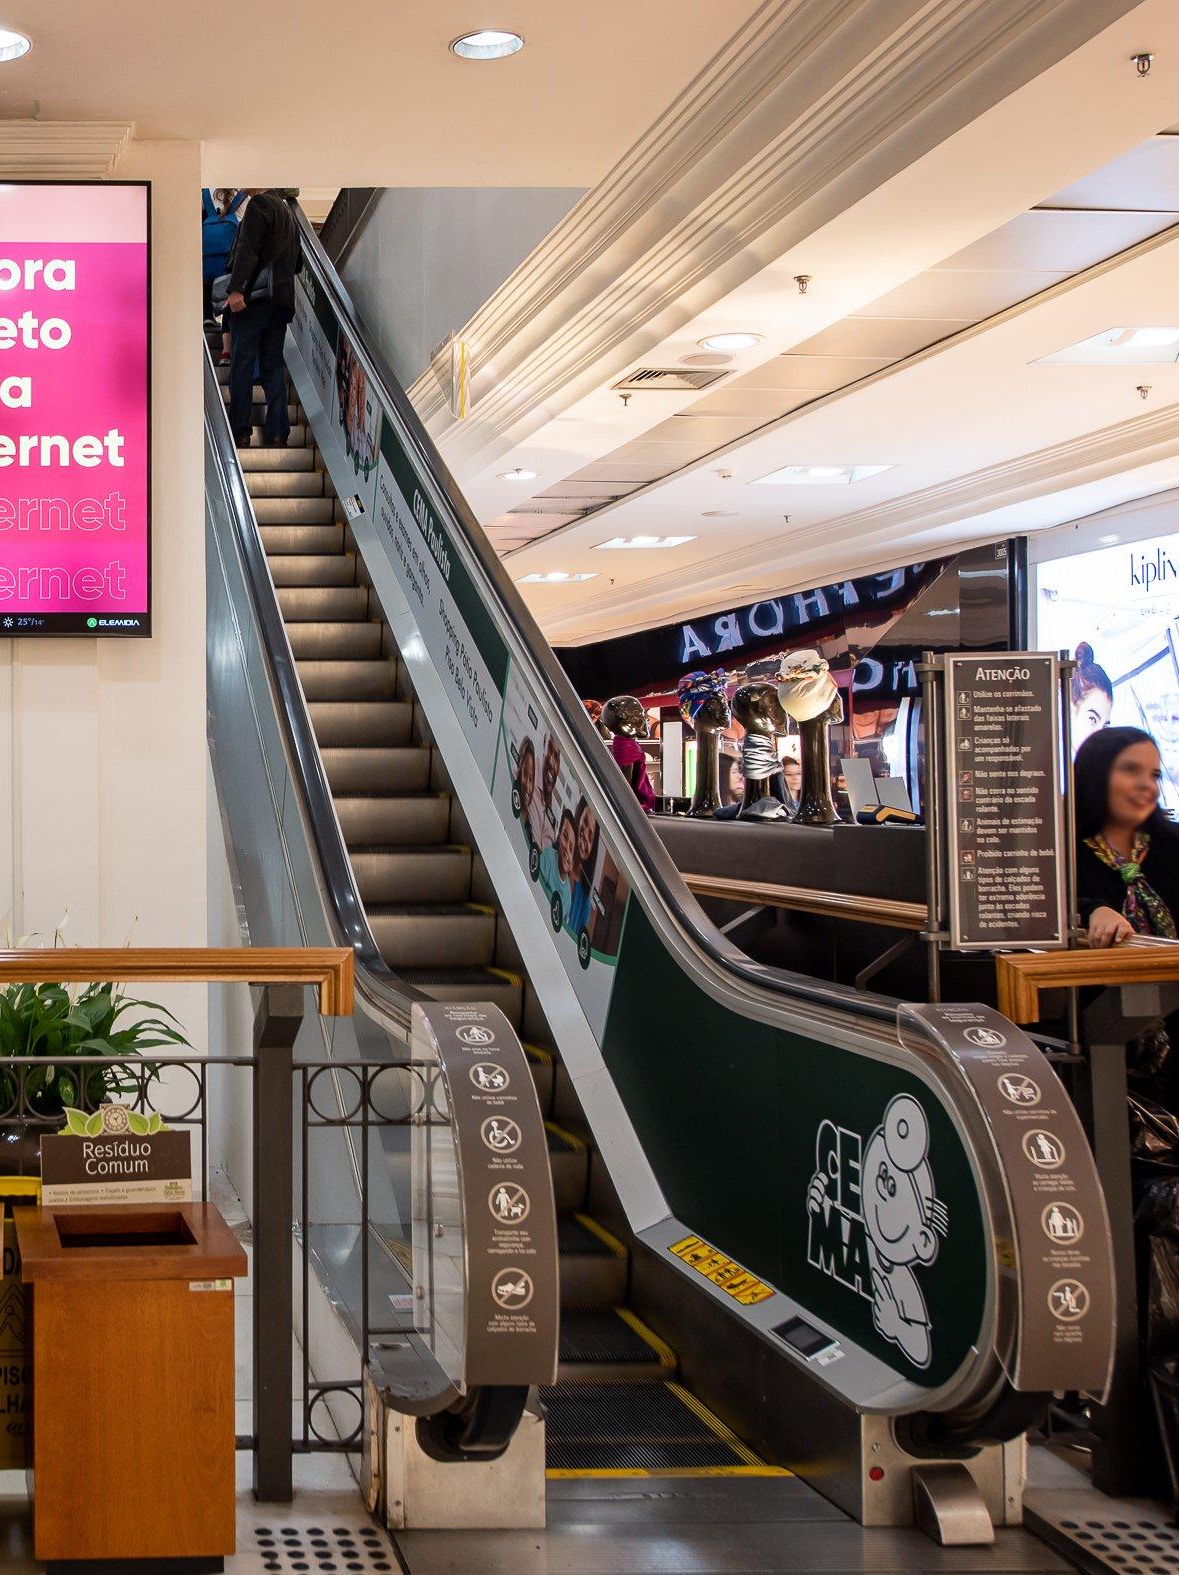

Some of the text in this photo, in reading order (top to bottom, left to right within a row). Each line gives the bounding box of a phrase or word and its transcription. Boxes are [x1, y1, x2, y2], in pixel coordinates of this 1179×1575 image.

[413, 488, 451, 582] CEMA Paulista
[98, 619, 141, 627] ELEMIDIA
[438, 597, 460, 651] Shopping
[473, 671, 492, 724] Paulista
[975, 666, 1030, 683] ATENÇÃO
[445, 644, 454, 675] Piso
[466, 690, 478, 728] Vista
[83, 1140, 152, 1159] Resíduo
[85, 1158, 149, 1175] Comum
